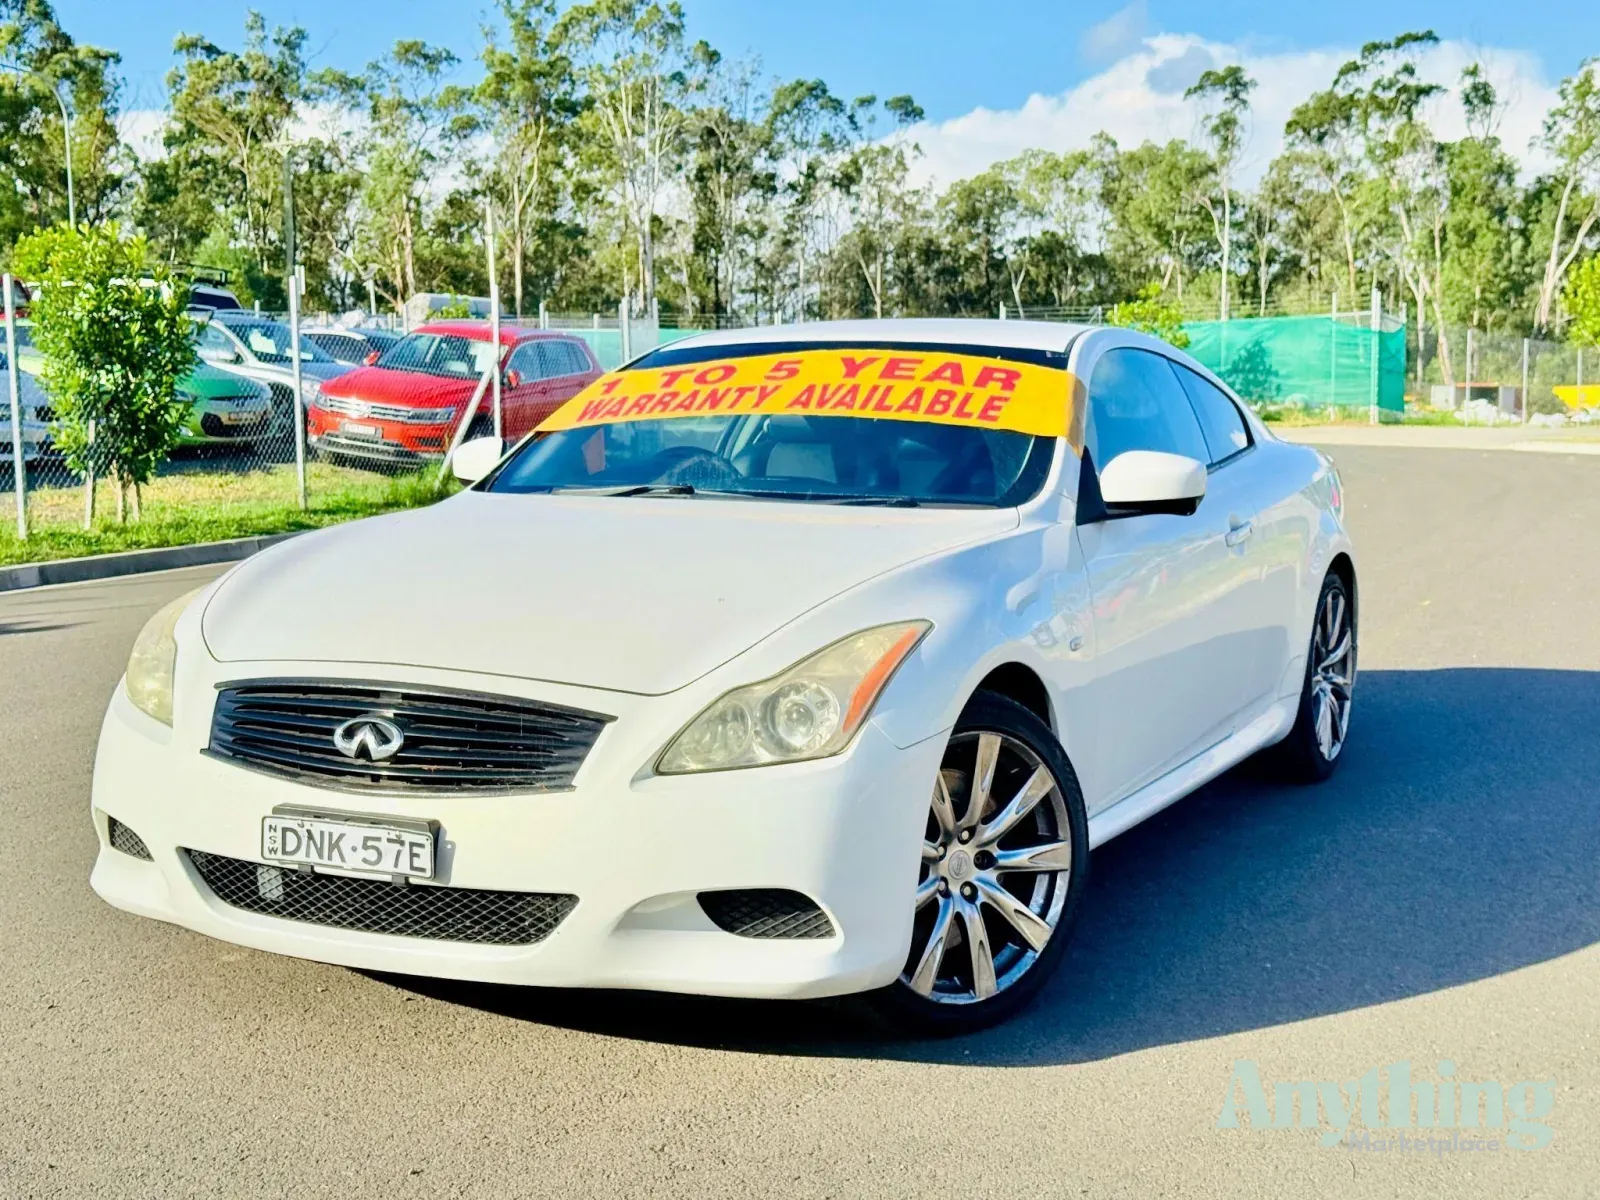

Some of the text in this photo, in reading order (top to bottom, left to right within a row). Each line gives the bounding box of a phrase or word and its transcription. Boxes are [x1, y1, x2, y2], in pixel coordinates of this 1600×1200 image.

[601, 356, 1022, 395] 1 TO 5 YEAR
[576, 383, 1011, 422] WARRANTY AVAILABLE
[268, 824, 278, 855] NSW
